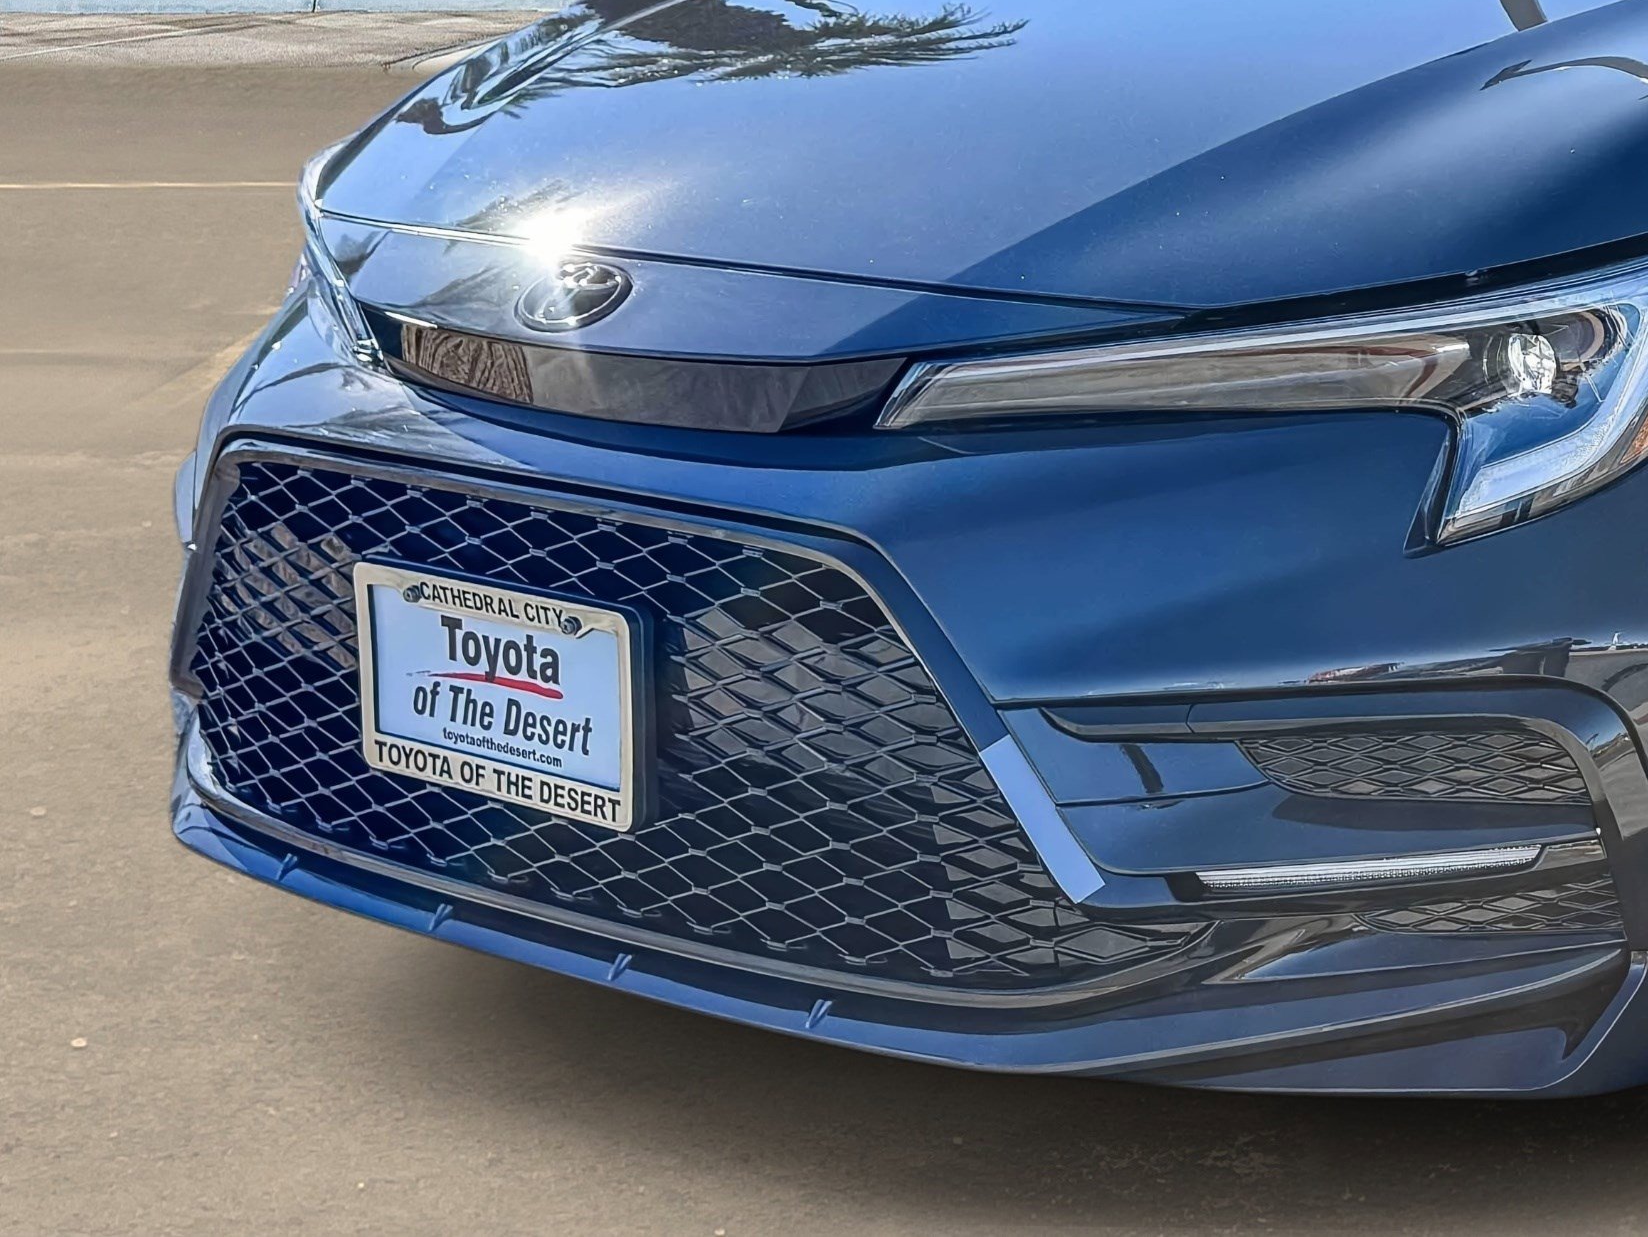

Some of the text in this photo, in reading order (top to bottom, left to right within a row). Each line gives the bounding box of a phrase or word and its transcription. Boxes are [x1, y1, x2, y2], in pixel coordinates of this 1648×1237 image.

[419, 581, 564, 626] CATHEDRAL CITY
[440, 614, 561, 685] Toyota
[413, 681, 593, 756] of The Desert
[443, 727, 563, 768] toyotaofthedesert.com
[374, 739, 621, 823] TOYOTA OF THE DESERT
